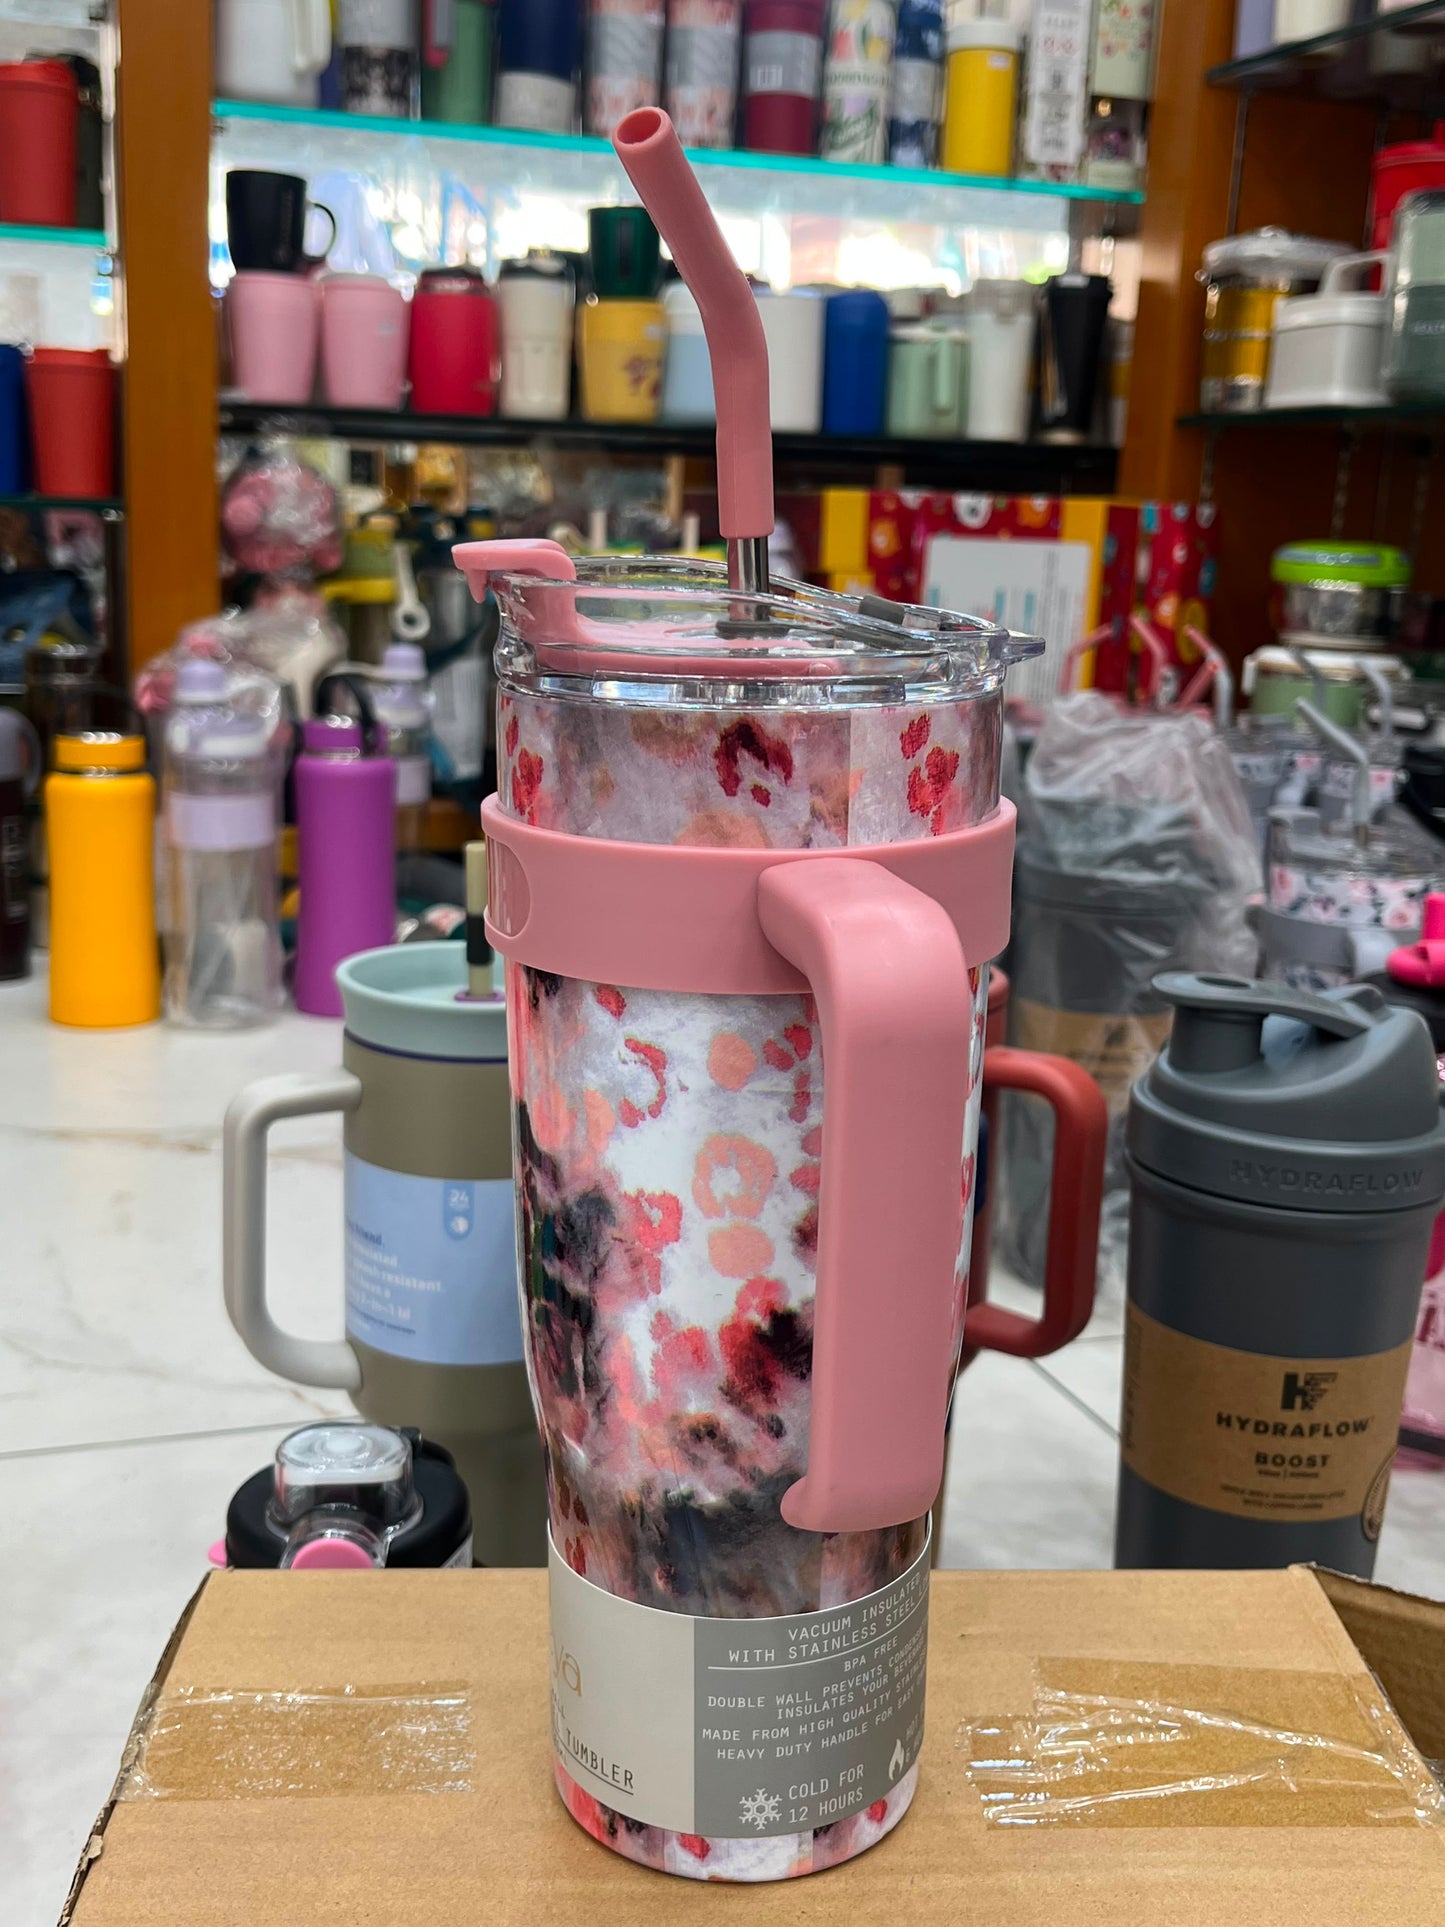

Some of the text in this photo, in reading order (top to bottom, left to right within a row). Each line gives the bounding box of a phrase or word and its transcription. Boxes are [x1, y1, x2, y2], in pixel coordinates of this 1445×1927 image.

[1230, 1159, 1424, 1194] HYDRAFLOW
[1216, 1411, 1370, 1438] HYDRAFLOW
[1255, 1452, 1330, 1468] BOOST
[728, 1595, 915, 1662] WITH STAINLESS STEEL
[788, 1616, 851, 1641] VACUUM
[844, 1635, 898, 1672] BPA FREE
[707, 1695, 765, 1708] DOUBLE
[776, 1690, 813, 1705] WALL
[822, 1664, 883, 1698] PREVENTS
[777, 1692, 854, 1720] INSULATES
[862, 1674, 889, 1695] YOUR
[702, 1728, 741, 1741] MADE
[752, 1727, 790, 1741] FROM
[799, 1717, 834, 1735] HIGH
[842, 1690, 891, 1722] QUALITY
[717, 1683, 915, 1760] HEAVY DUTY HANDLE FOR EASY
[566, 1727, 634, 1789] TUMBLER
[788, 1764, 864, 1801] COLD FOR
[788, 1787, 863, 1824] 12 HOURS
